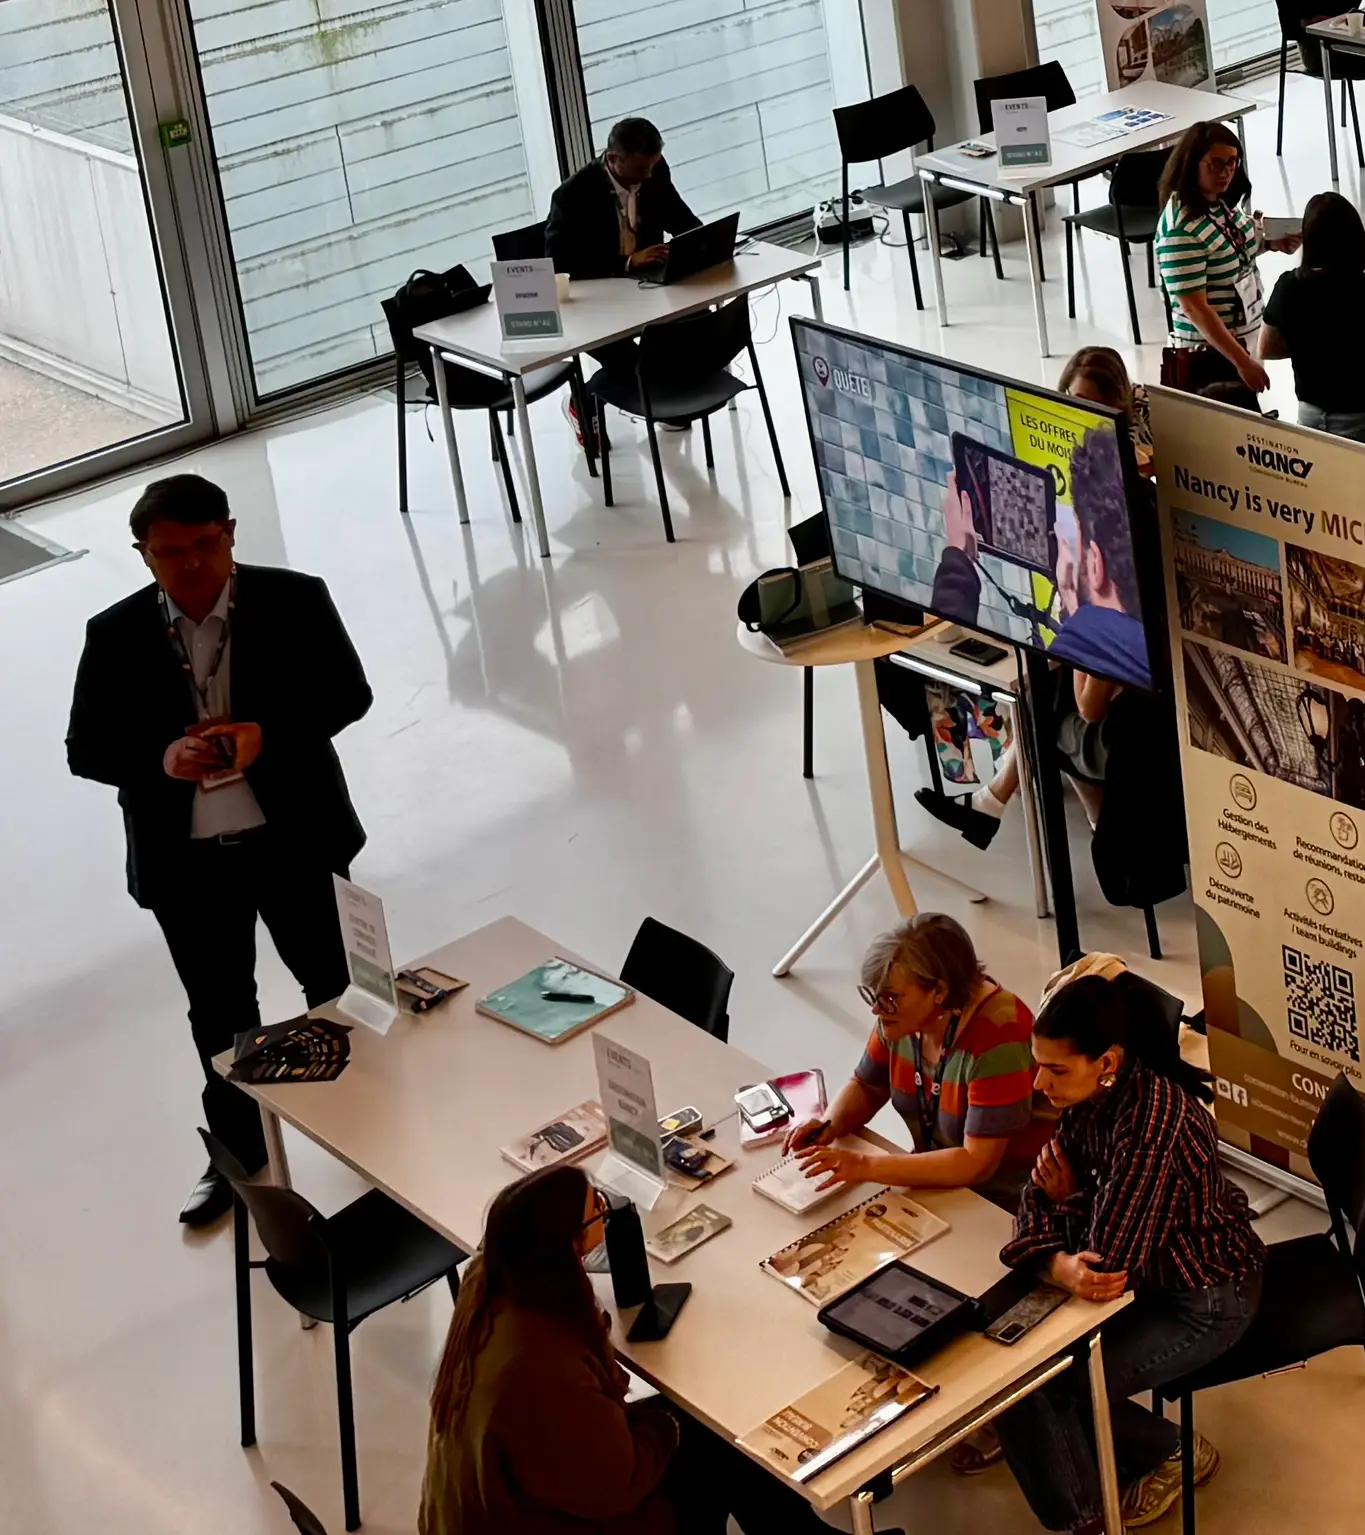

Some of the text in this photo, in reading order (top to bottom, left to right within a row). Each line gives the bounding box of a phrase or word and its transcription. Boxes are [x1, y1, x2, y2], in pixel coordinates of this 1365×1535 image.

[506, 265, 534, 274] EVENTS
[833, 367, 869, 397] QUÊTE
[1020, 411, 1077, 442] LES OFFRES
[1029, 434, 1045, 451] DU
[1246, 433, 1299, 455] DESTINATION
[1174, 464, 1239, 511] Nancy
[1244, 485, 1262, 513] is
[1266, 498, 1314, 535] very
[1217, 818, 1277, 850] Hébergements
[1223, 808, 1270, 834] Gestion des
[1292, 848, 1303, 860] de
[1304, 853, 1343, 877] réunions,
[1205, 888, 1261, 919] du patrimoine
[1208, 876, 1254, 904] Découverte
[1283, 907, 1363, 948] Activités récréatives
[1296, 926, 1318, 942] team
[1318, 934, 1357, 959] buildings
[1290, 1039, 1309, 1056] Pour
[1309, 1050, 1320, 1061] en
[1345, 1065, 1362, 1079] plus
[1291, 1072, 1330, 1101] CON
